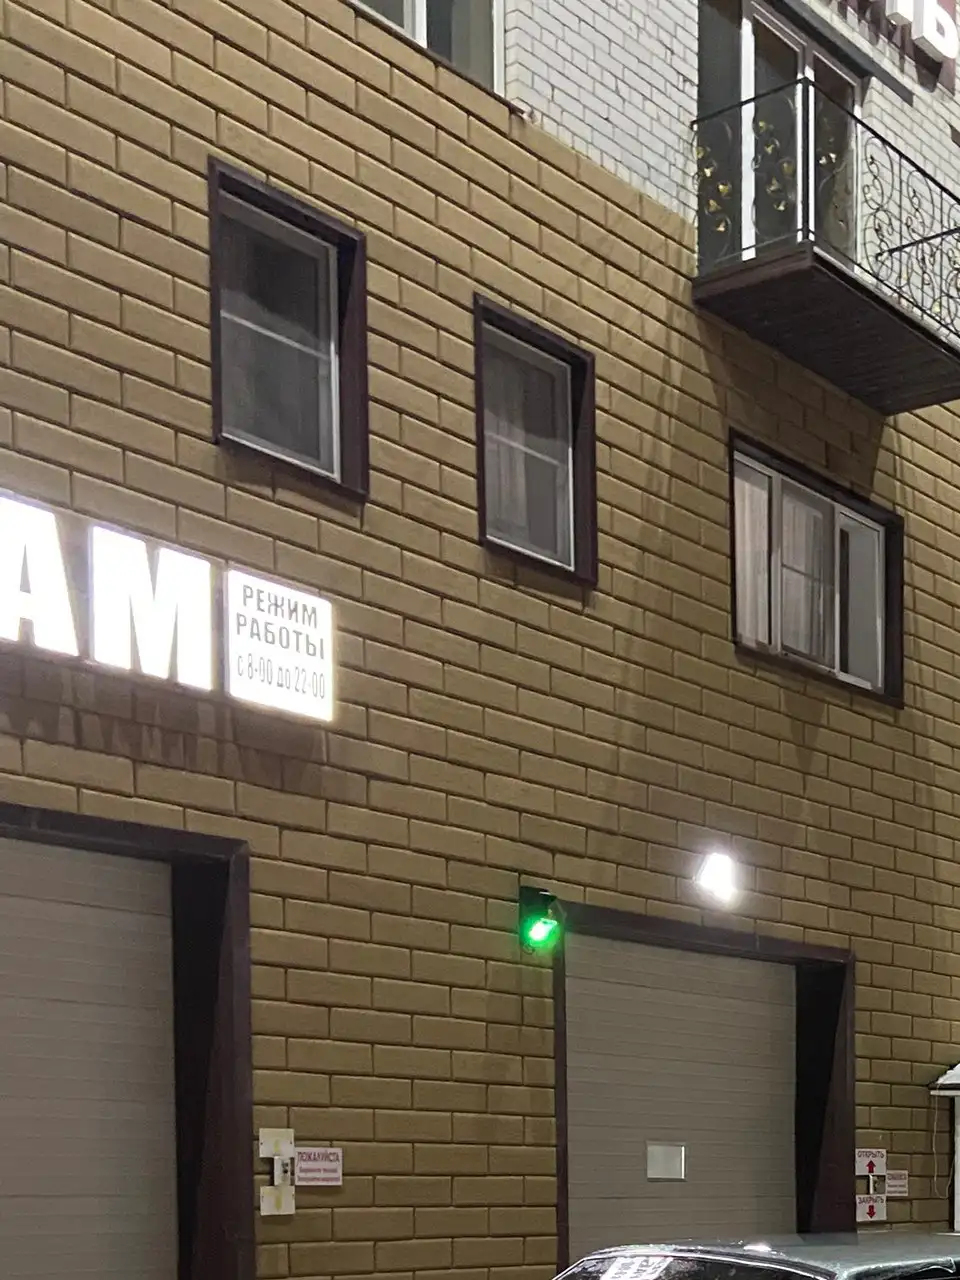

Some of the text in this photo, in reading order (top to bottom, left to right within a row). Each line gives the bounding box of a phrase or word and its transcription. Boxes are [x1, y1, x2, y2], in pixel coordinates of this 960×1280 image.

[243, 585, 317, 629] РЕЖИМ
[236, 612, 324, 660] РАБОТЫ
[247, 653, 273, 685] 8-00
[276, 666, 291, 690] до
[857, 1150, 885, 1159] ОТКРЫТЬ
